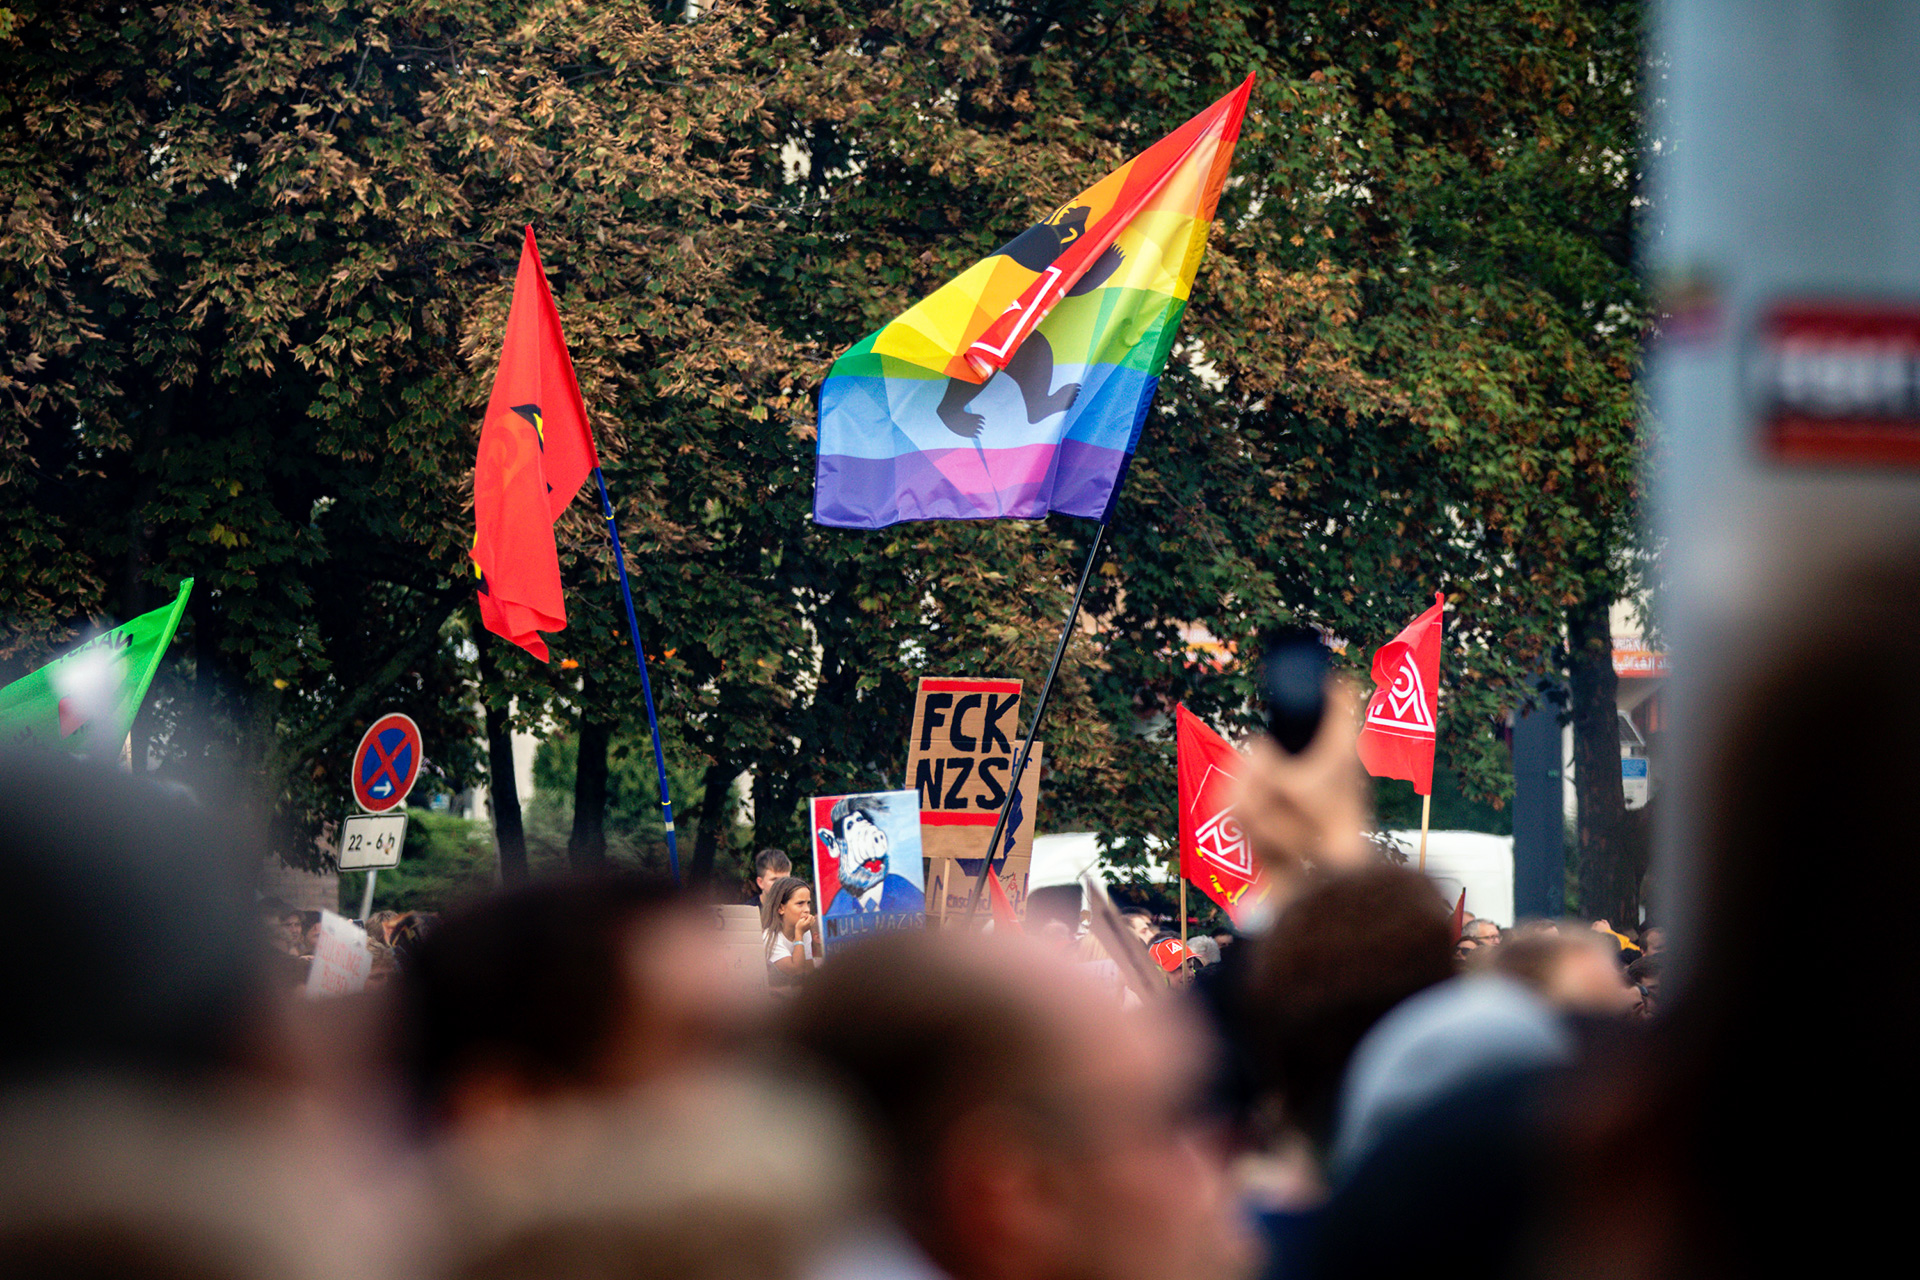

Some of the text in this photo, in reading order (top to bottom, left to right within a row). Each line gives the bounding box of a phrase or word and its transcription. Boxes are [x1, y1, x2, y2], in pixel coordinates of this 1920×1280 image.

[920, 693, 1020, 754] FCK
[916, 757, 1009, 810] NZS
[348, 834, 363, 851] 22
[376, 833, 383, 850] 6
[388, 832, 395, 849] h
[826, 912, 925, 938] NULL NAZIS
